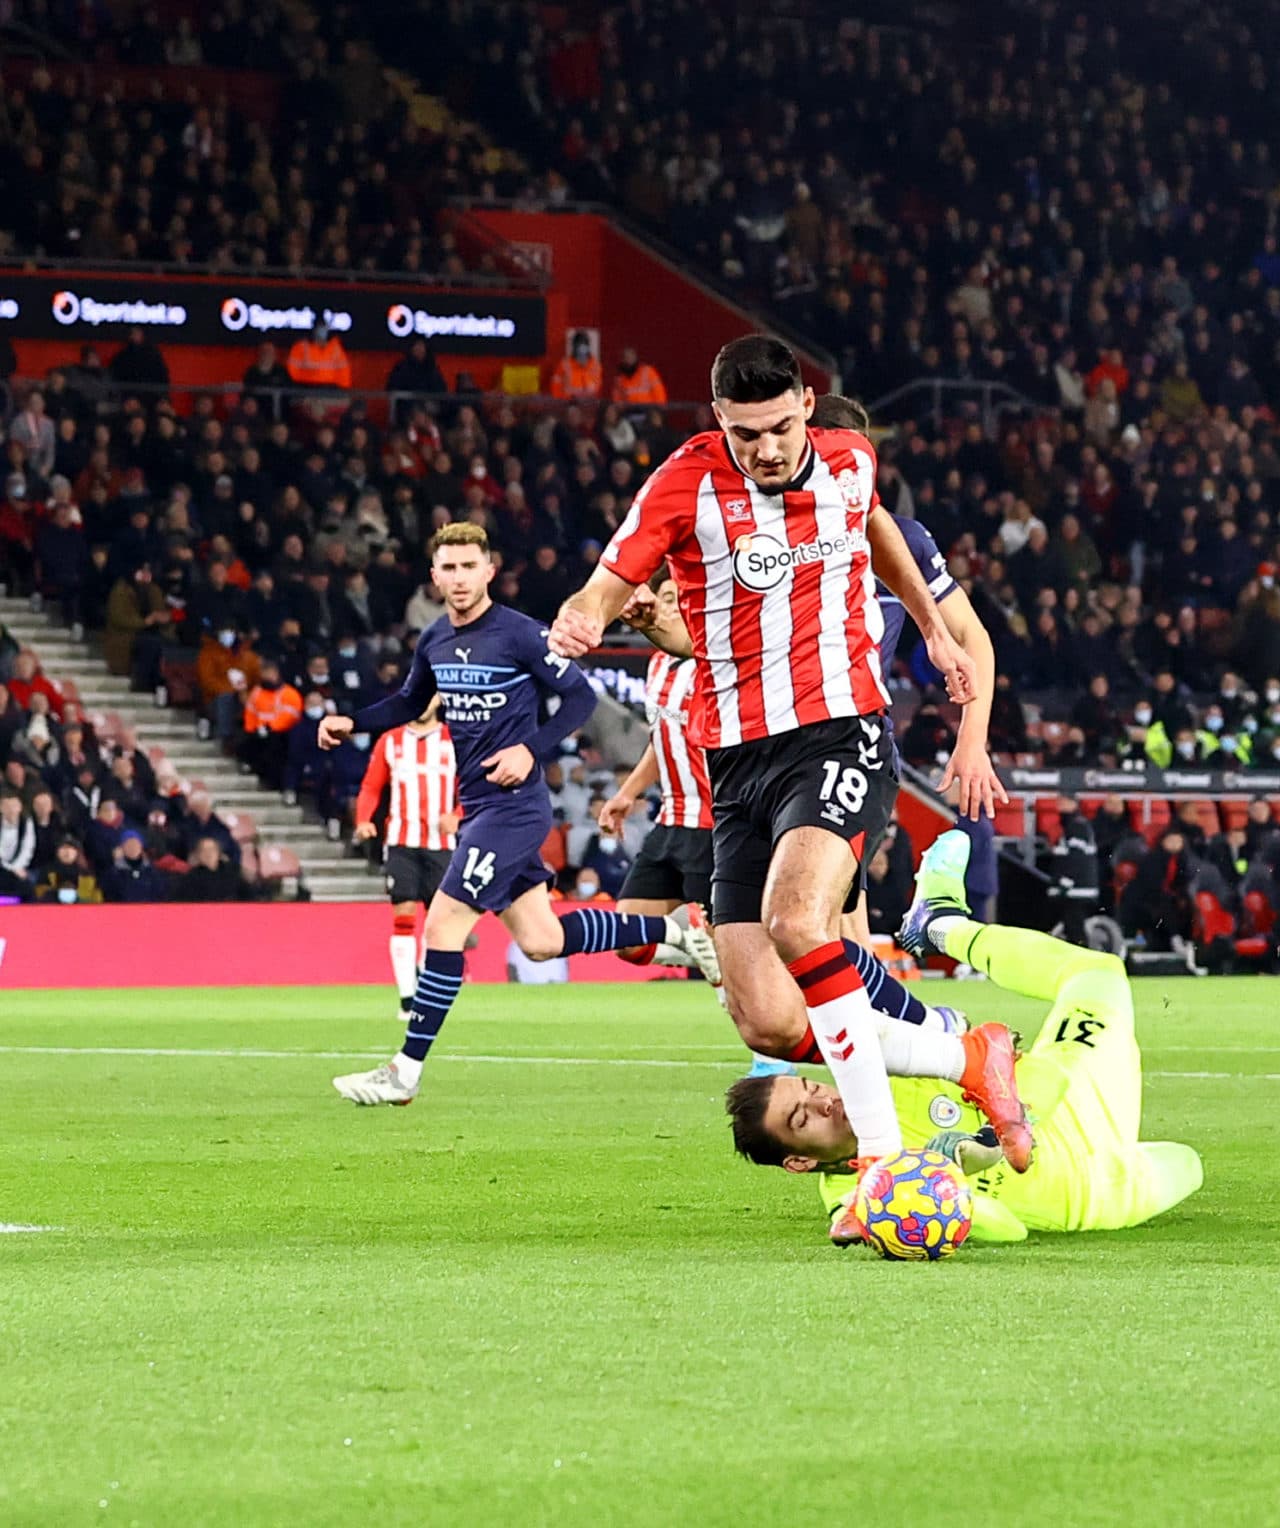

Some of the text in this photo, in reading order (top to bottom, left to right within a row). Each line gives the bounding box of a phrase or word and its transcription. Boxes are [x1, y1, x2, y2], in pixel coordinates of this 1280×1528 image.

[460, 669, 493, 684] CITY
[440, 692, 507, 709] TIHAD
[819, 760, 869, 814] 18
[462, 847, 496, 886] 14
[1054, 1017, 1105, 1049] 31
